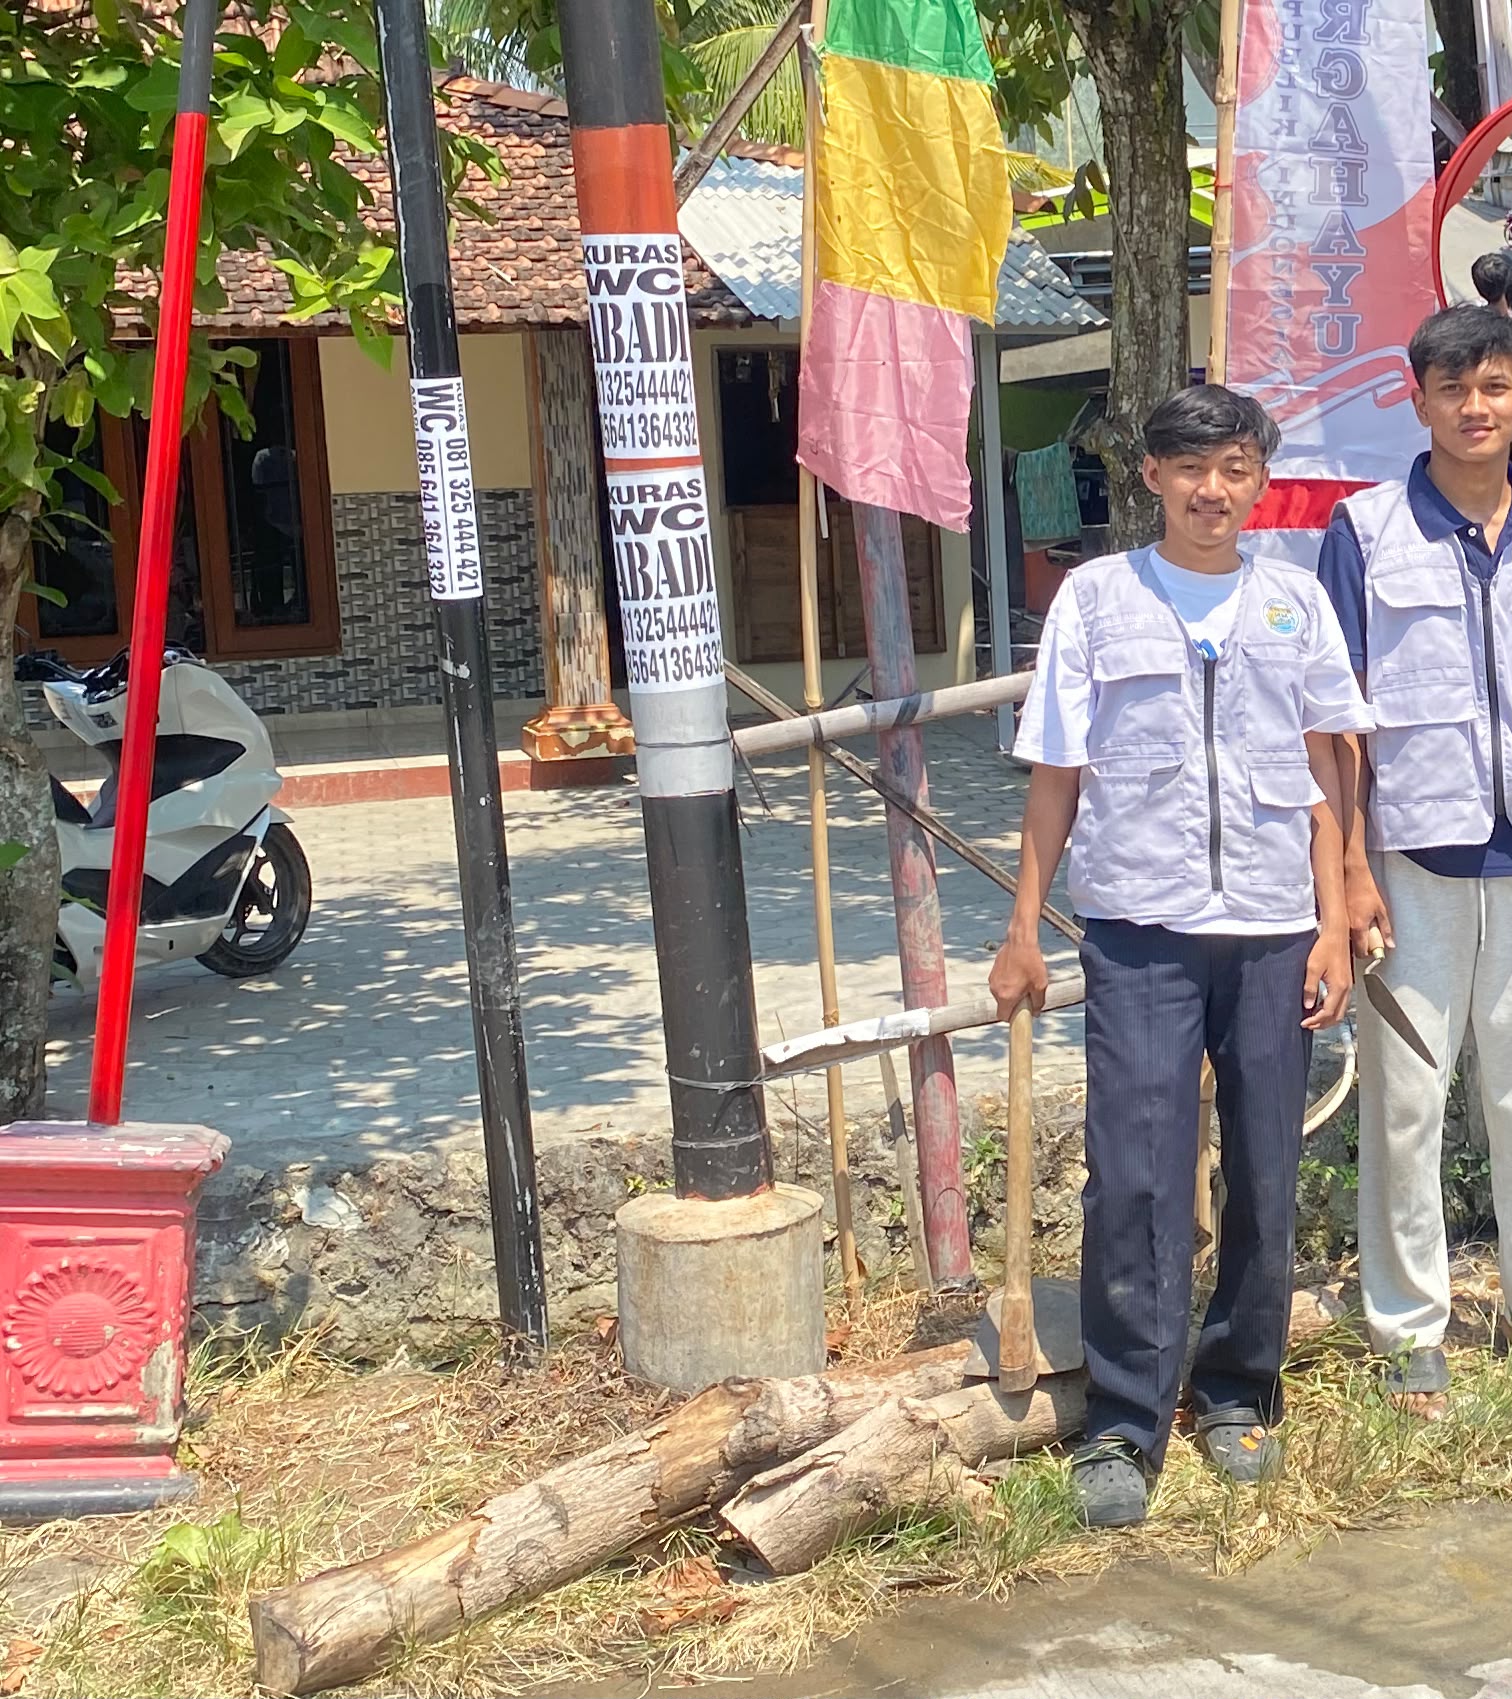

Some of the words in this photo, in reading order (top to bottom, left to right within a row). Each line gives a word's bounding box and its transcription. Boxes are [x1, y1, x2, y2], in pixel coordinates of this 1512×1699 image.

[583, 244, 679, 264] KURAS
[585, 268, 681, 296] WC
[597, 370, 694, 406] 1325444421
[417, 383, 457, 433] WC
[456, 382, 466, 432] KURAS
[601, 411, 698, 449] 5641364332
[416, 439, 436, 475] 085
[446, 437, 469, 472] 081
[421, 479, 439, 512] 641
[449, 478, 472, 513] 325
[608, 478, 702, 505] KURAS
[453, 518, 476, 554] 444
[610, 503, 705, 536] WC
[424, 520, 444, 554] 364
[428, 560, 447, 594] 332
[456, 558, 480, 592] 421
